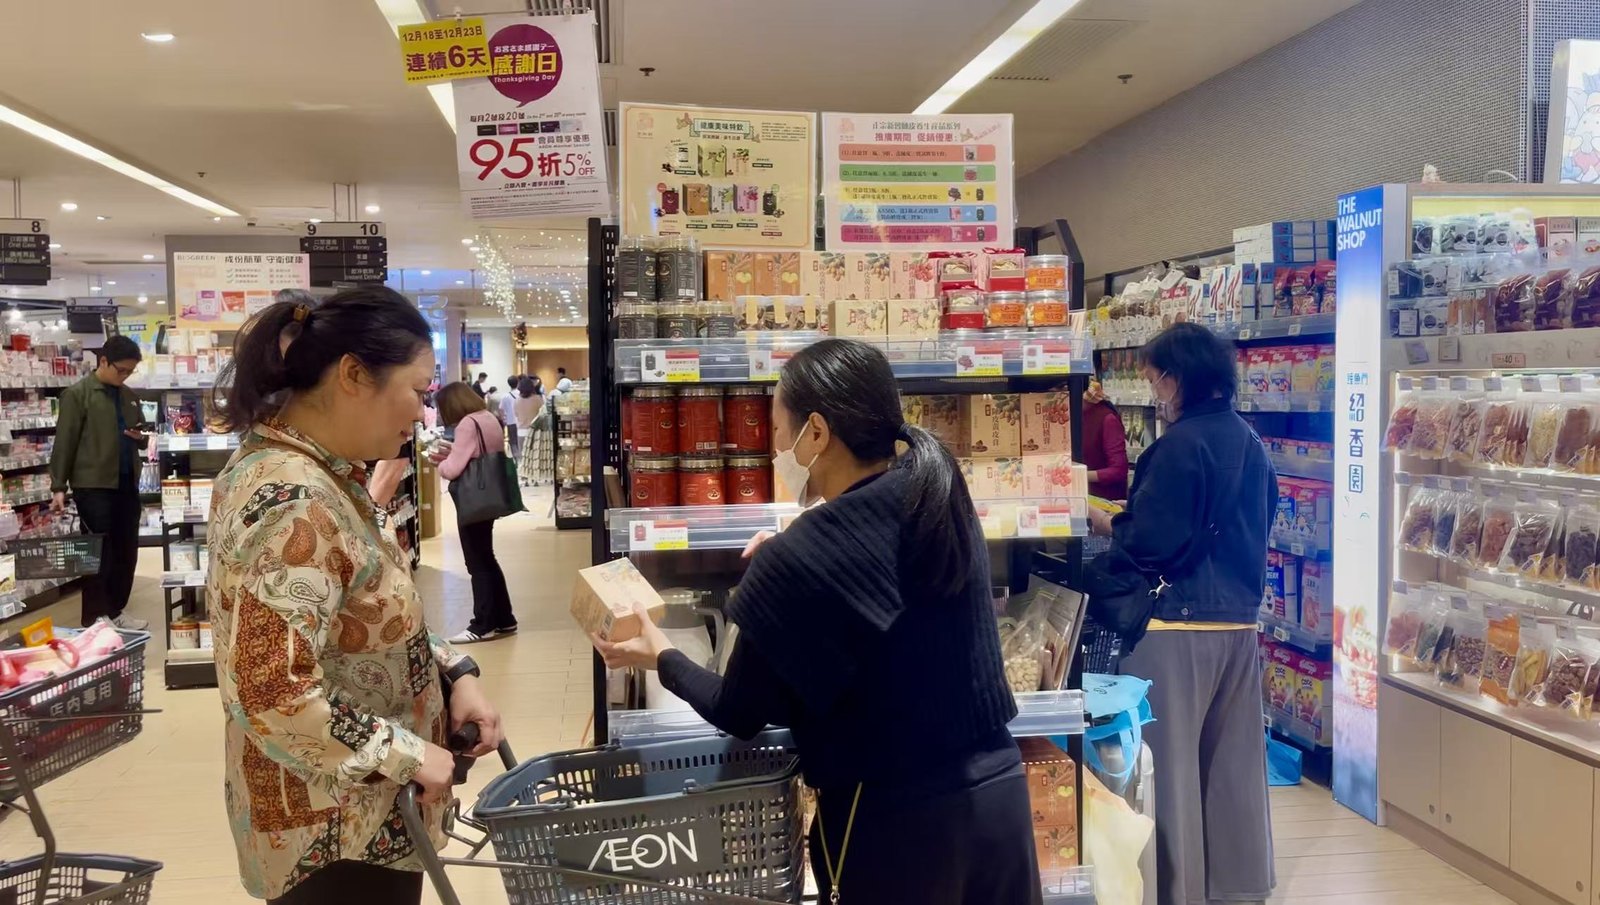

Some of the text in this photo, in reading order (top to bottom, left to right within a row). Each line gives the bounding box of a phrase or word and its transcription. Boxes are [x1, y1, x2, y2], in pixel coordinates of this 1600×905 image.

[403, 26, 483, 42] 12月18至12月23日
[406, 45, 487, 73] 連續6天
[493, 53, 558, 75] 感謝日
[494, 74, 541, 84] Thanksgiving
[542, 73, 556, 82] Day
[578, 166, 596, 176] OFF
[1338, 196, 1357, 216] THE
[31, 221, 41, 233] 8
[1337, 208, 1382, 233] WALNUT
[307, 223, 317, 236] 9
[360, 223, 379, 236] 10
[1337, 230, 1367, 251] SHOP
